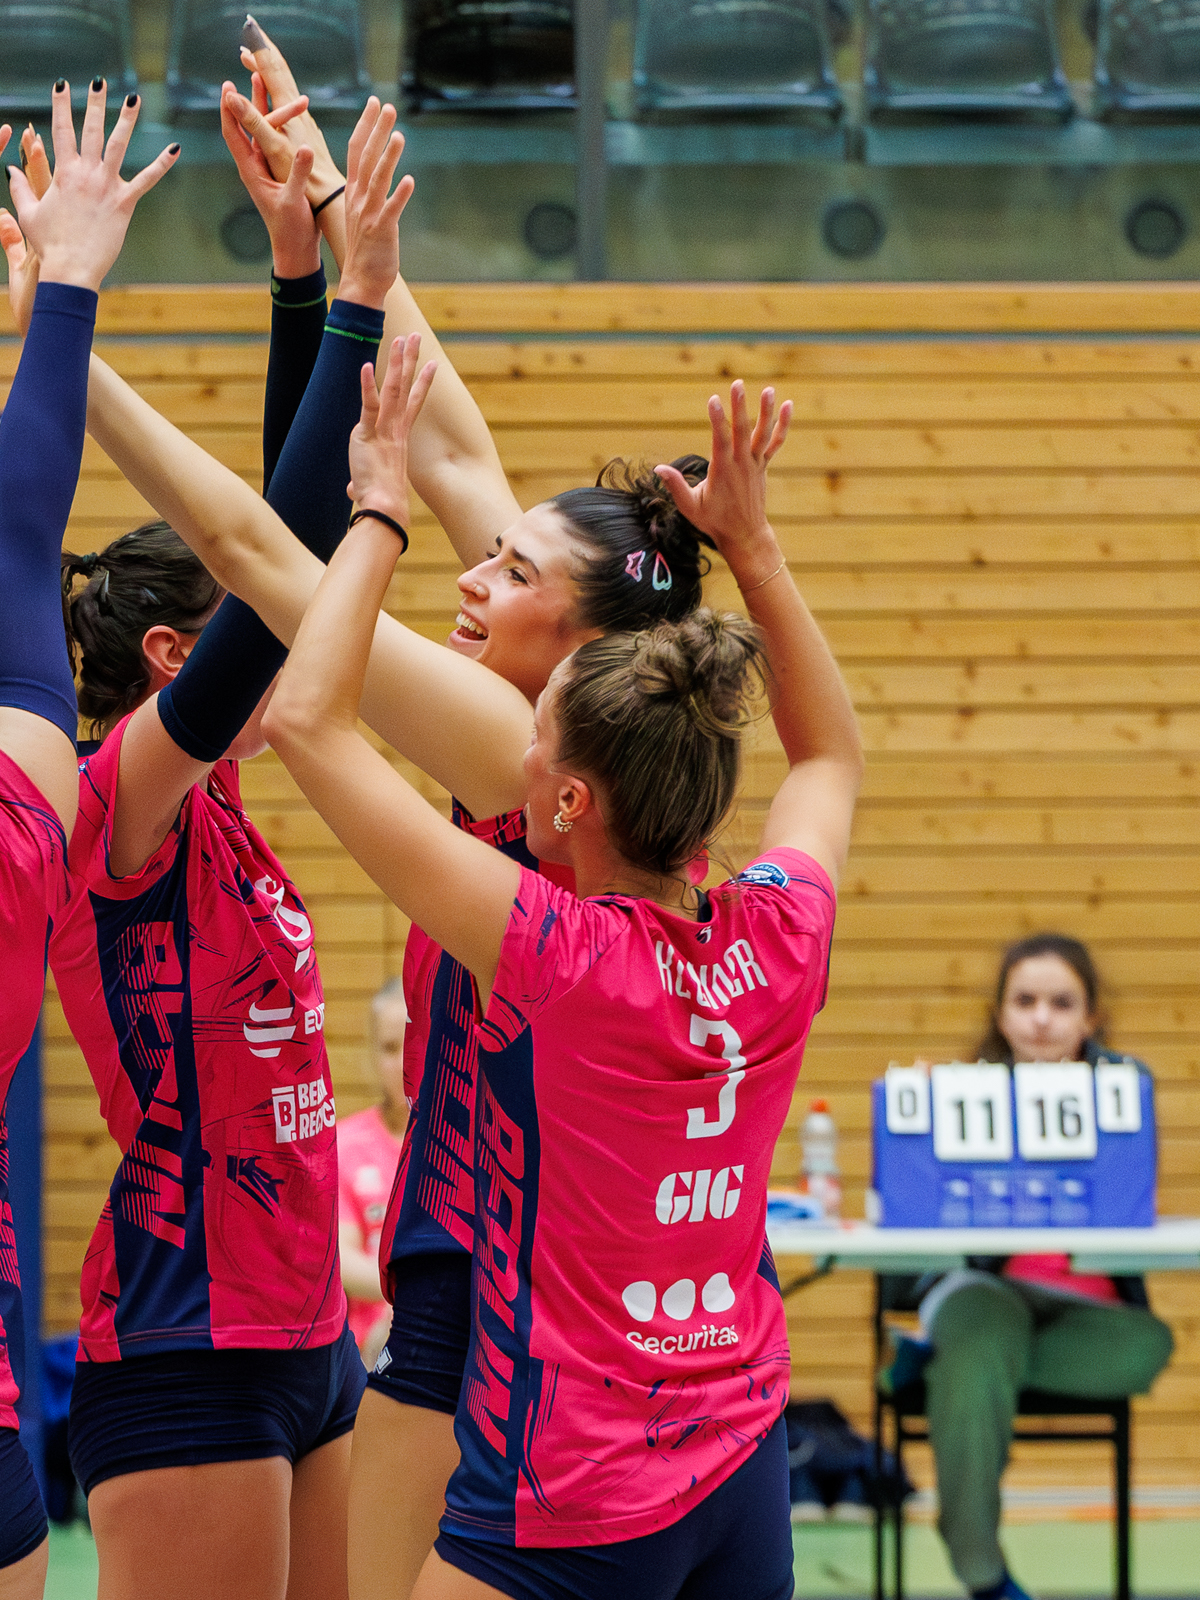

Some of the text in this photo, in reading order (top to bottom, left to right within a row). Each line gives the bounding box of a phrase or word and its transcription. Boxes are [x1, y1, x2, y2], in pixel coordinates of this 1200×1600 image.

[686, 1013, 747, 1140] 3
[899, 1086, 1122, 1142] 0 11 16 1
[655, 1164, 745, 1225] GIG
[626, 1323, 740, 1356] Securitas
